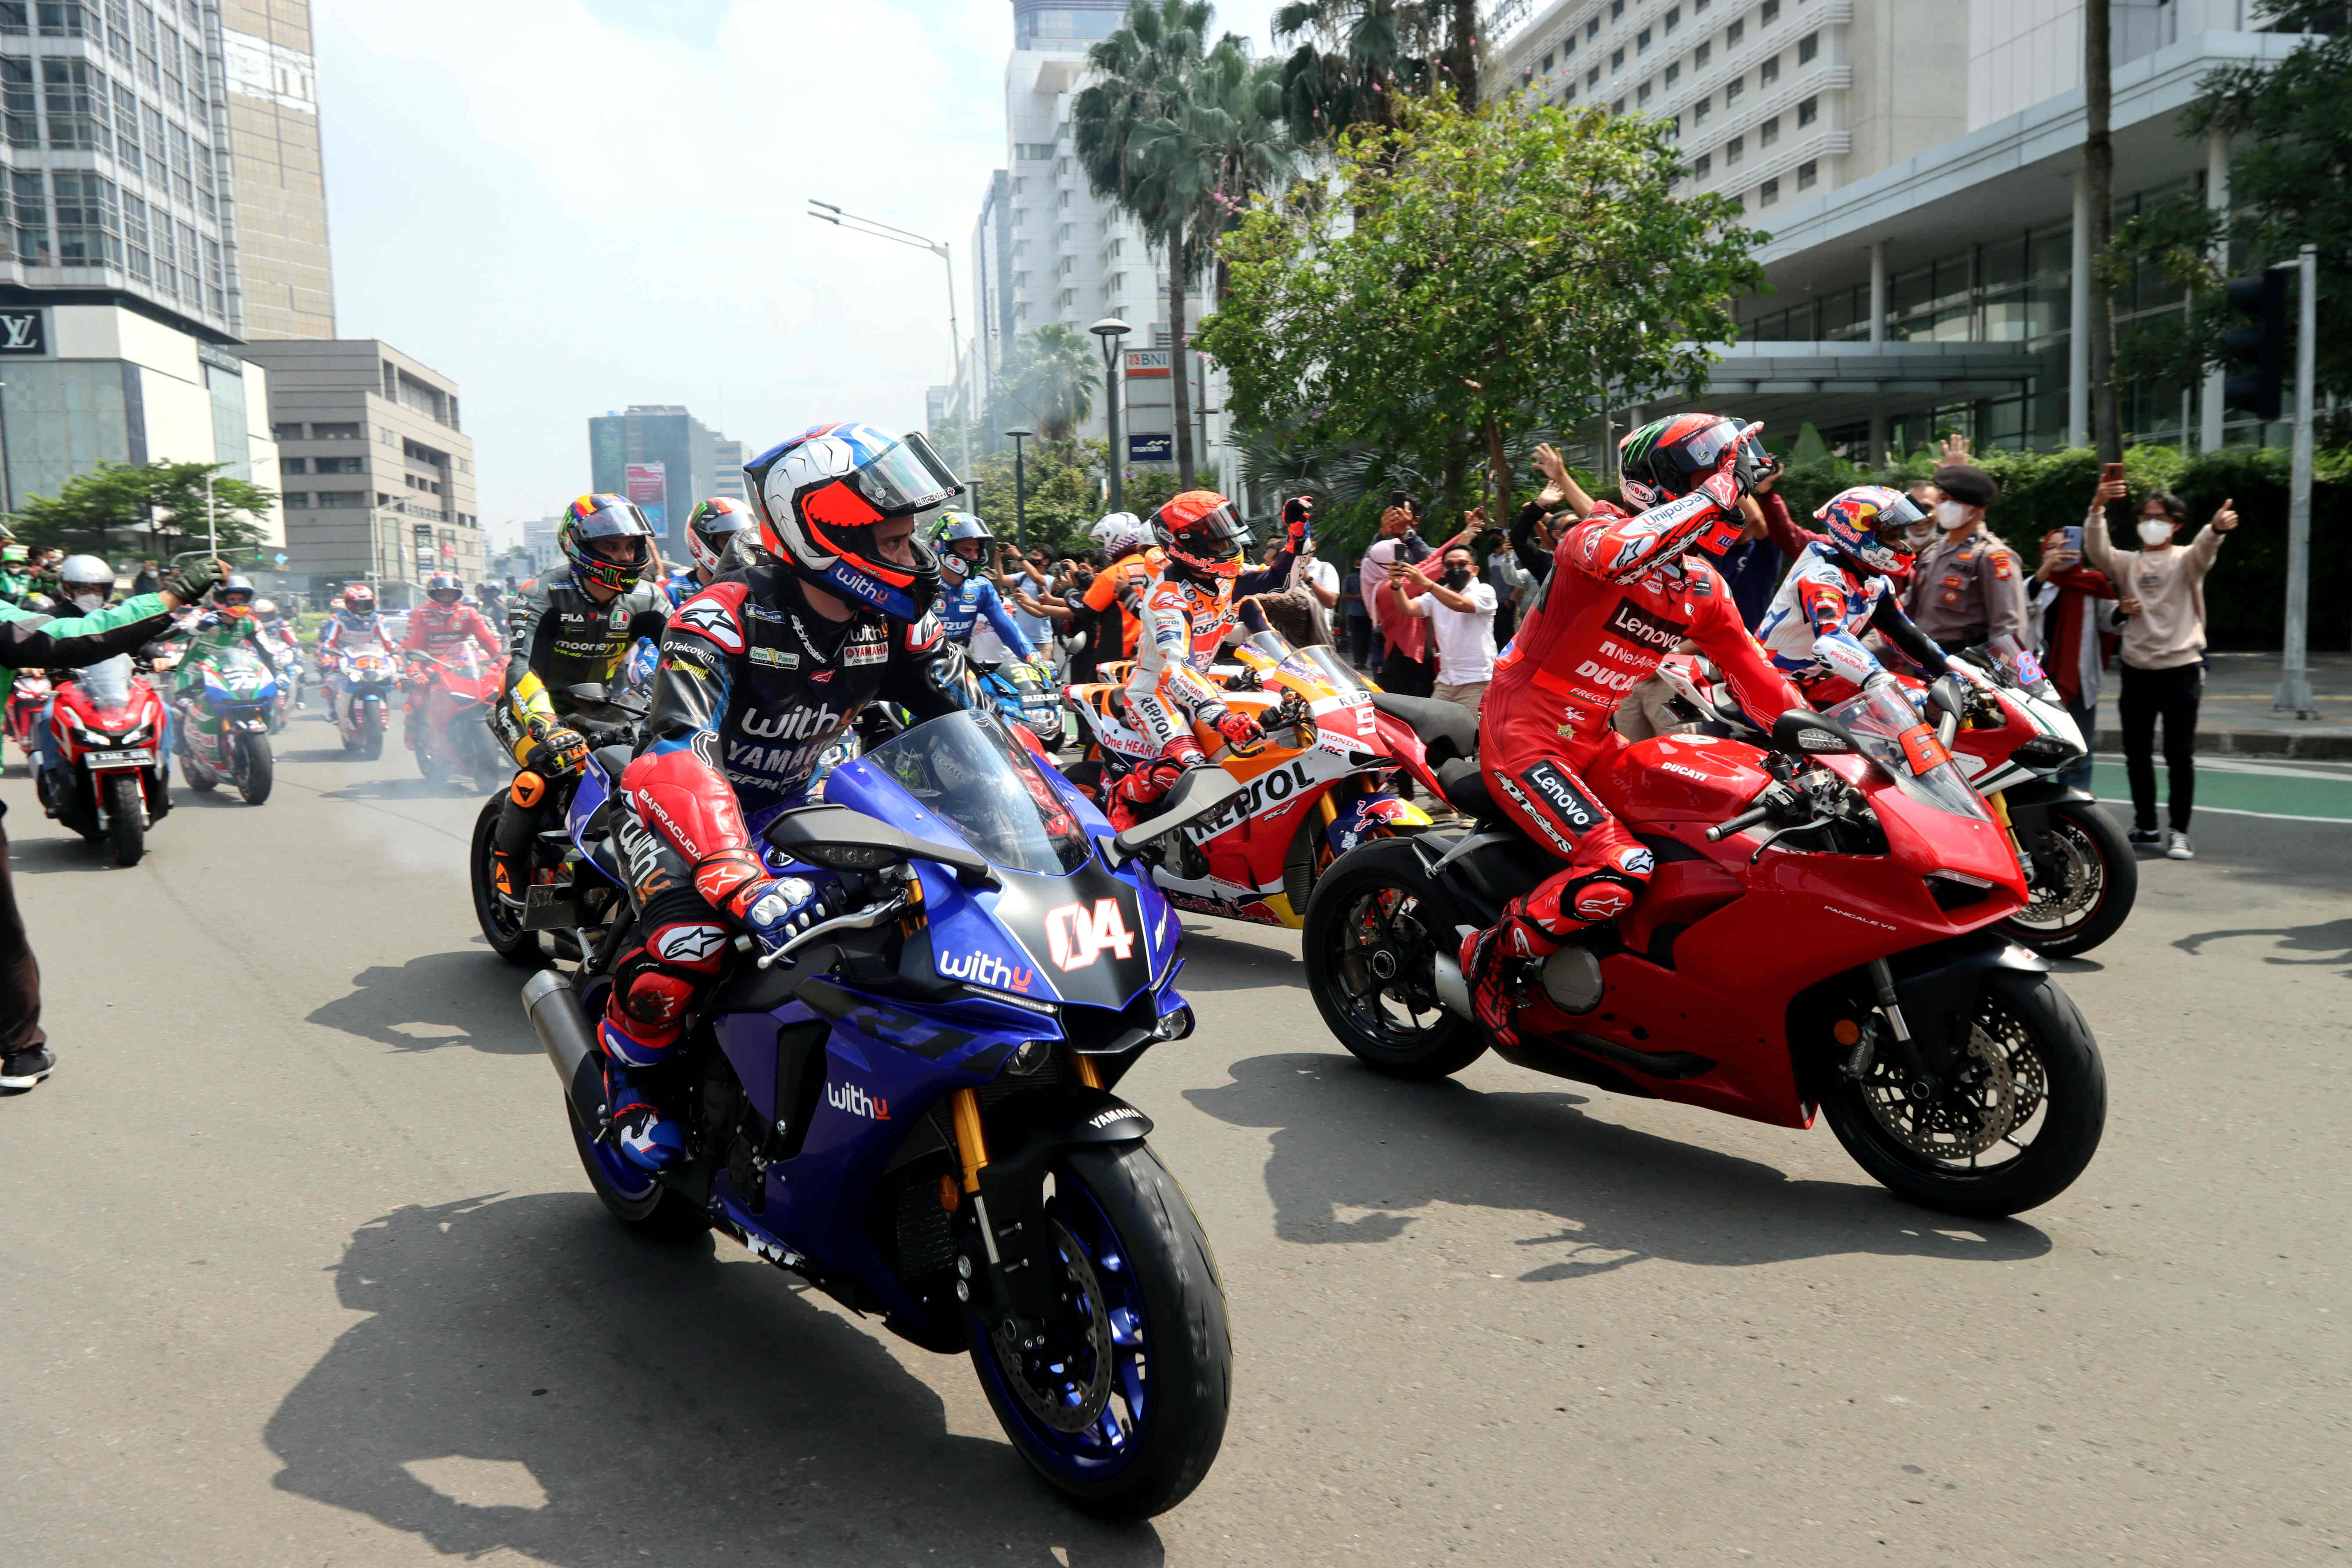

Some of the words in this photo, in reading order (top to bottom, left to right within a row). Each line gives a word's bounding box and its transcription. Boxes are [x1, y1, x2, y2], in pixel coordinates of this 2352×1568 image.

[1142, 354, 1167, 365] BNI
[916, 491, 946, 505] Muc-Off
[1627, 481, 1654, 502] SUOMY
[1194, 583, 1216, 596] REPSOL
[560, 614, 584, 622] FILA
[1615, 607, 1681, 649] Lenovo
[673, 642, 715, 664] Telcowin
[752, 649, 768, 659] Green
[777, 654, 796, 664] Power
[855, 644, 888, 657] YAMAHA
[1830, 651, 1868, 674] PRAMAC
[1011, 667, 1042, 684] 36
[1021, 693, 1060, 703] SUZUKI
[1168, 677, 1201, 709] REPSO
[1138, 697, 1173, 743] REPSOL
[1355, 706, 1377, 737] 9
[1103, 733, 1123, 749] One
[1321, 732, 1361, 750] HONDA
[1661, 762, 1708, 782] DUCATI
[1532, 767, 1589, 825] Lenovo
[1494, 771, 1573, 854] alpinestars
[638, 788, 702, 861] BARRACUDA
[1210, 876, 1245, 891] HONDA
[1824, 905, 1879, 926] PANIGALE
[1044, 898, 1135, 972] 04
[1851, 1041, 1867, 1070] brembo
[1089, 1108, 1143, 1129] YAMAHA
